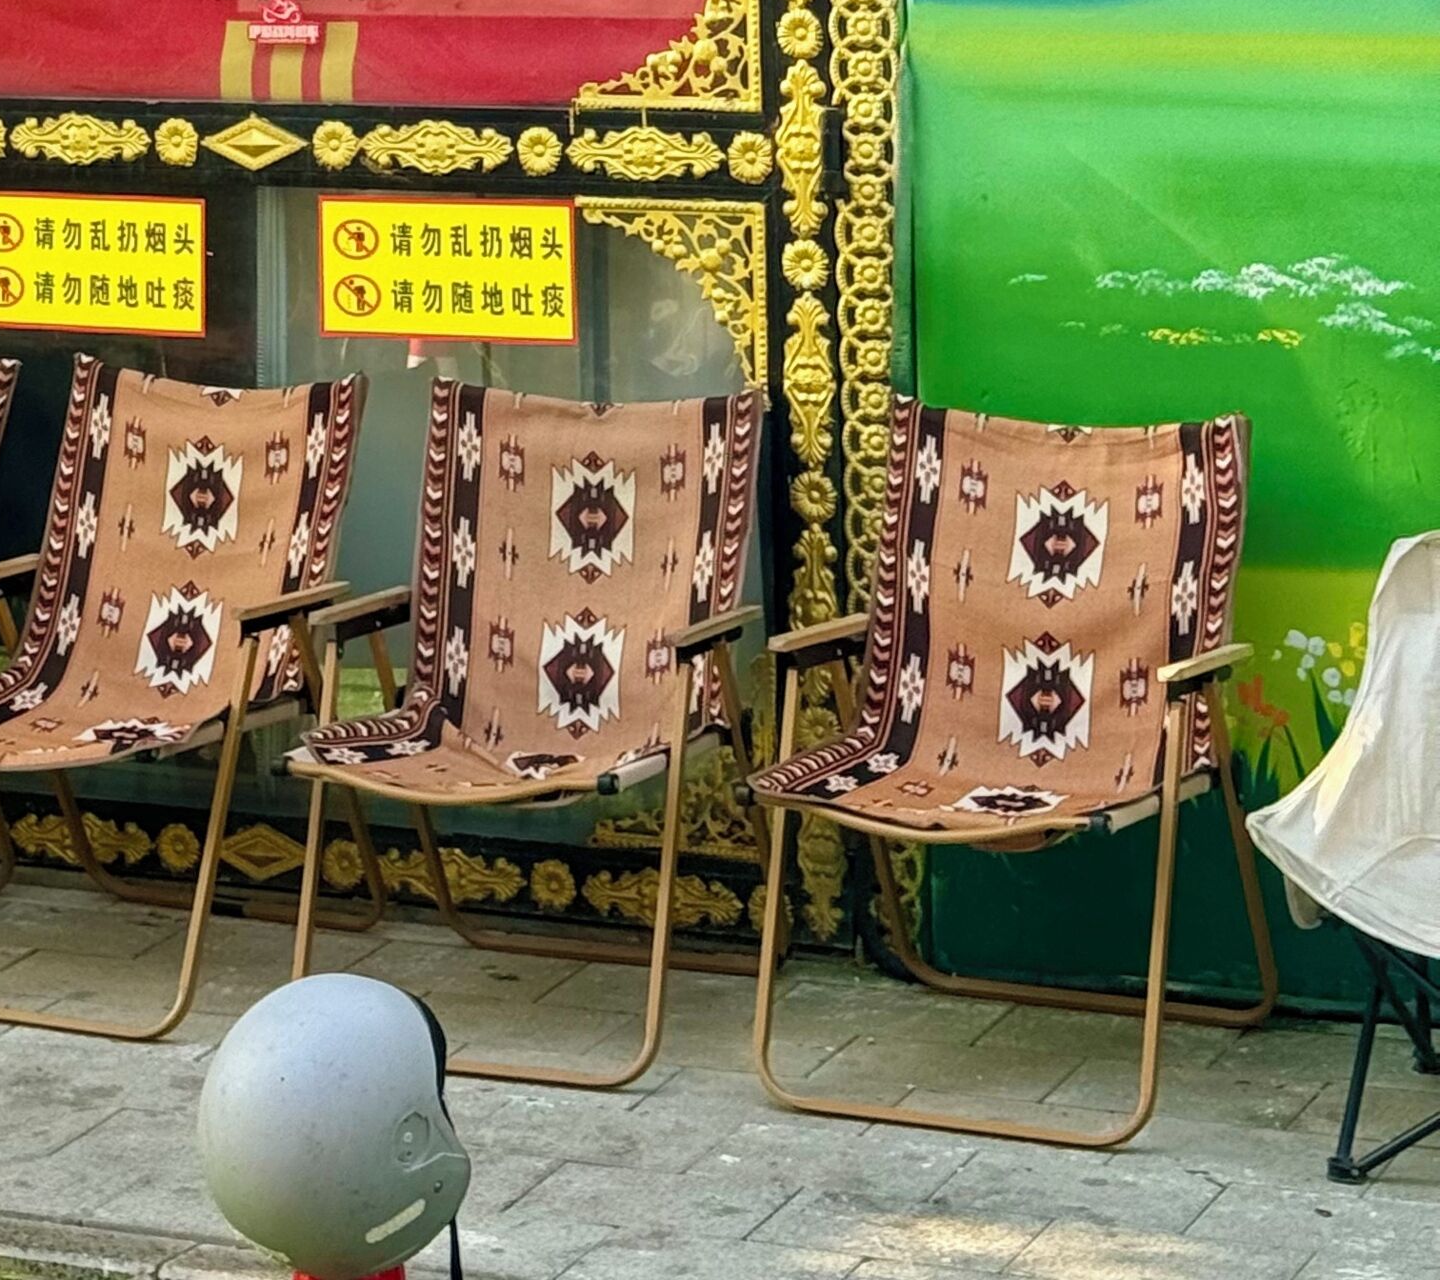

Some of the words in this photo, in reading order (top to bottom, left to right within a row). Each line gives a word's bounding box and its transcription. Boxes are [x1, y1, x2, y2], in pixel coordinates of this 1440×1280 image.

[33, 216, 195, 256] 请勿乱扔烟头
[389, 222, 564, 261] 请勿乱扔烟头
[33, 271, 195, 312] 请勿随地吐痰
[390, 279, 566, 319] 请勿随地吐痰
